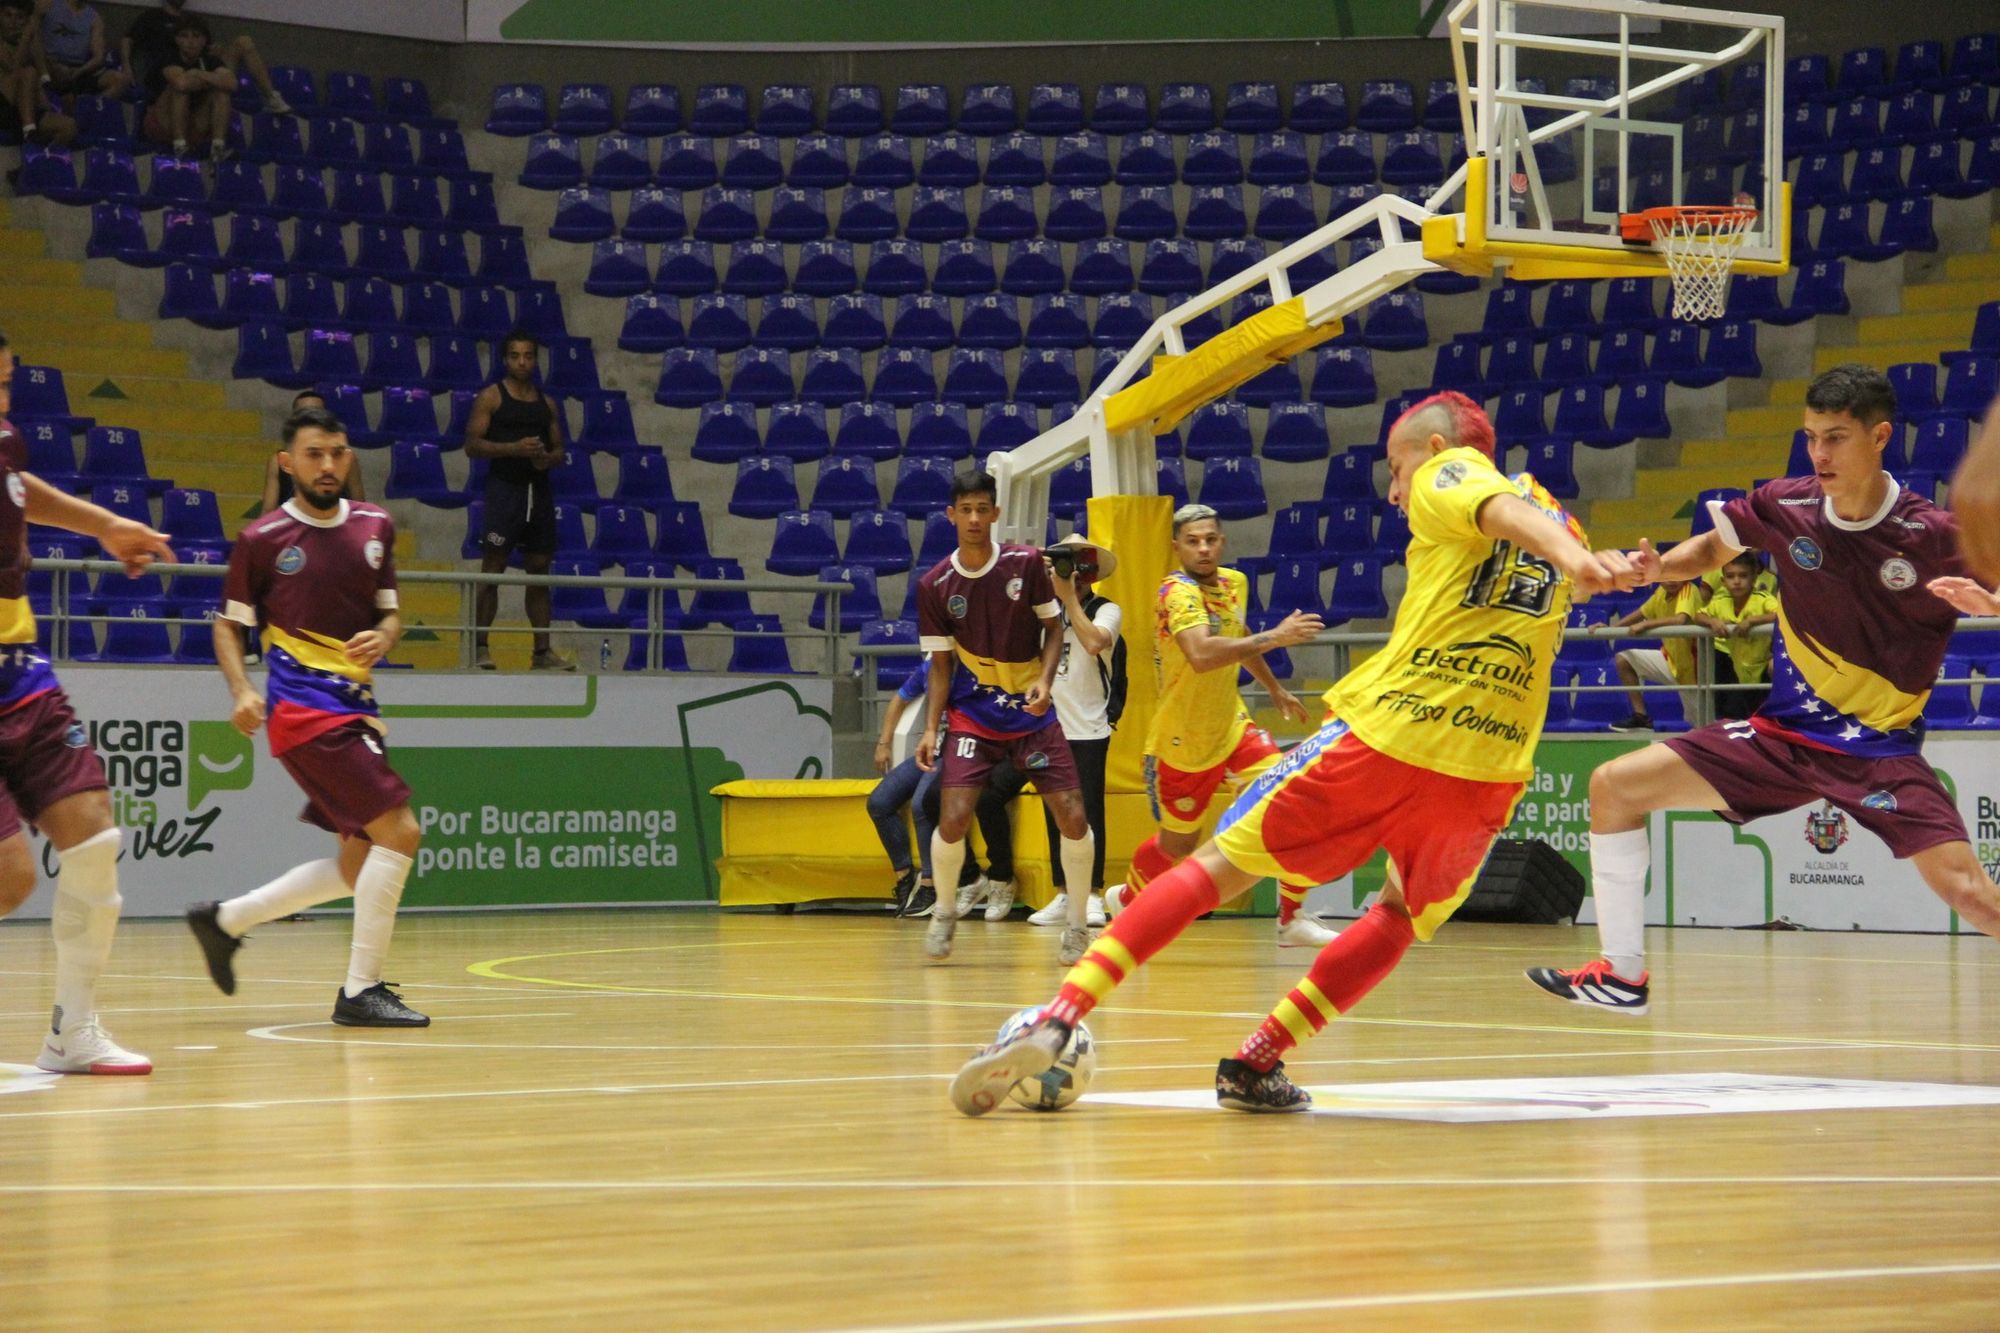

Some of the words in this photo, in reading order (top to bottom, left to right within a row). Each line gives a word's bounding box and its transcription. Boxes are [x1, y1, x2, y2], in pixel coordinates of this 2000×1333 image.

[1957, 89, 1972, 104] 32
[1902, 96, 1915, 110] 31
[234, 164, 242, 176] 4
[412, 179, 420, 191] 7
[1348, 186, 1365, 199] 20
[1901, 201, 1915, 214] 27
[113, 208, 121, 220] 1
[251, 219, 261, 231] 3
[314, 225, 322, 237] 4
[499, 239, 508, 251] 7
[614, 243, 624, 255] 8
[682, 243, 692, 255] 9
[750, 243, 765, 254] 10
[821, 243, 833, 254] 11
[186, 269, 194, 281] 1
[306, 278, 316, 290] 3
[365, 283, 373, 294] 4
[423, 286, 432, 299] 5
[649, 297, 657, 309] 8
[715, 297, 726, 309] 9
[781, 297, 796, 309] 10
[848, 297, 862, 309] 11
[917, 297, 931, 309] 12
[260, 328, 268, 340] 1
[1669, 329, 1682, 343] 21
[1724, 325, 1739, 339] 22
[389, 336, 398, 349] 3
[450, 341, 458, 353] 4
[569, 348, 577, 360] 6
[686, 350, 695, 362] 7
[758, 350, 768, 363] 8
[830, 350, 839, 362] 9
[897, 351, 913, 362] 10
[969, 350, 984, 362] 11
[1041, 350, 1055, 362] 12
[1905, 366, 1912, 380] 1
[1968, 362, 1977, 377] 2
[29, 369, 46, 384] 26
[1514, 393, 1526, 406] 17
[604, 401, 613, 414] 5
[723, 404, 734, 416] 6
[794, 405, 802, 416] 7
[864, 404, 873, 416] 8
[935, 404, 944, 416] 9
[1002, 405, 1018, 417] 10
[1213, 404, 1228, 416] 13
[36, 426, 53, 440] 25
[1936, 423, 1945, 437] 3
[107, 430, 124, 445] 26
[413, 446, 422, 458] 1
[565, 452, 573, 466] 3
[640, 456, 648, 468] 4
[760, 459, 771, 471] 5
[921, 459, 932, 471] 7
[841, 459, 851, 472] 6
[1075, 460, 1083, 472] 9
[1224, 460, 1239, 473] 11
[113, 489, 129, 504] 25
[184, 492, 201, 506] 26
[554, 507, 563, 520] 2
[617, 509, 626, 523] 3
[676, 512, 685, 524] 4
[1289, 511, 1301, 524] 11
[1343, 508, 1356, 521] 12
[799, 514, 810, 526] 5
[873, 514, 884, 526] 6
[47, 547, 64, 560] 20
[573, 565, 579, 577] 1
[647, 566, 655, 578] 2
[718, 567, 726, 580] 3
[841, 569, 851, 581] 4
[1292, 565, 1300, 578] 9
[1352, 562, 1364, 576] 10
[1579, 614, 1587, 627] 2
[885, 624, 893, 636] 3
[1411, 648, 1535, 692] Electrolit
[1938, 666, 1945, 679] 9
[1598, 672, 1606, 684] 4
[1452, 705, 1529, 748] Colombia
[956, 736, 977, 759] 10
[1560, 773, 1573, 798] y
[420, 806, 471, 835] Por
[481, 805, 677, 839] Bucaramanga
[133, 806, 222, 861] vez
[1977, 821, 2000, 839] m
[417, 842, 506, 878] ponte
[515, 837, 541, 869] la
[550, 836, 678, 869] camiseta
[1840, 861, 1849, 871] DE
[1789, 873, 1865, 885] BUCARAMANGA
